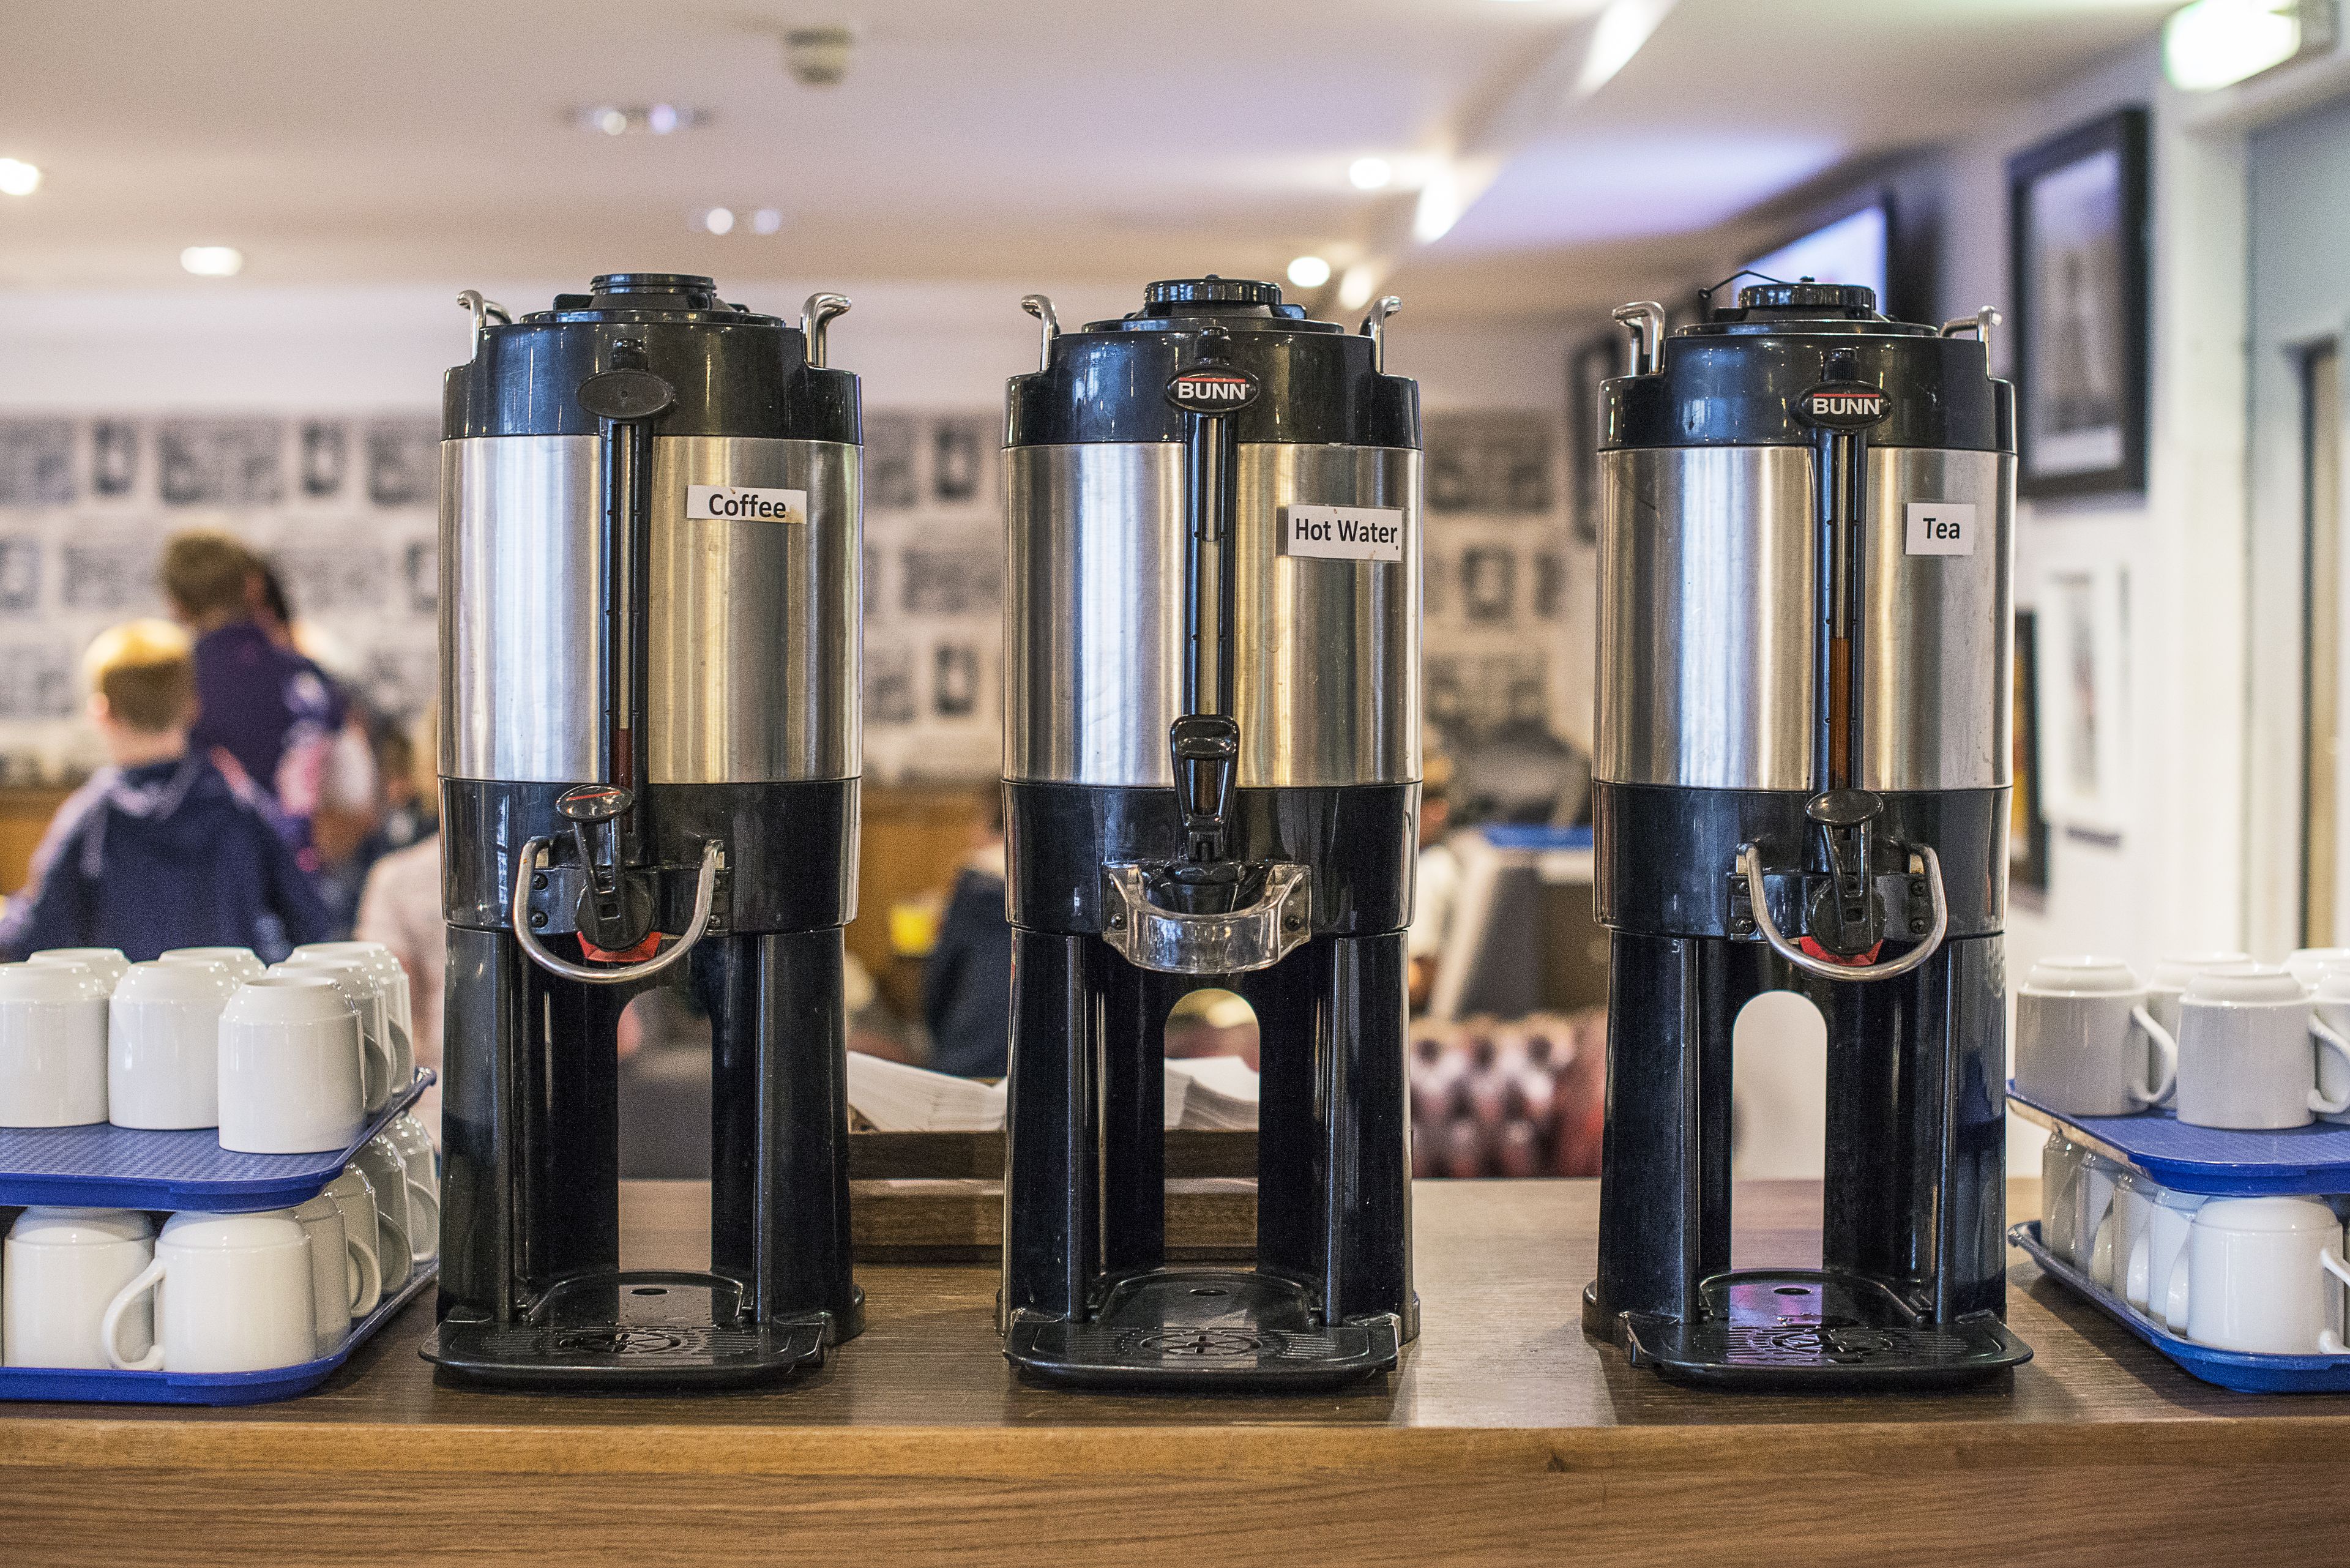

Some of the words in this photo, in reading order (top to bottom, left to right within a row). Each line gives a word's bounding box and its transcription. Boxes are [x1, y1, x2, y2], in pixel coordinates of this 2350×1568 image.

[1178, 382, 1246, 400] BUNN
[1813, 398, 1880, 415] BUNN
[709, 493, 786, 519] Coffee
[1296, 518, 1332, 541] Hot
[1337, 520, 1398, 543] Water
[1922, 517, 1960, 539] Tea
